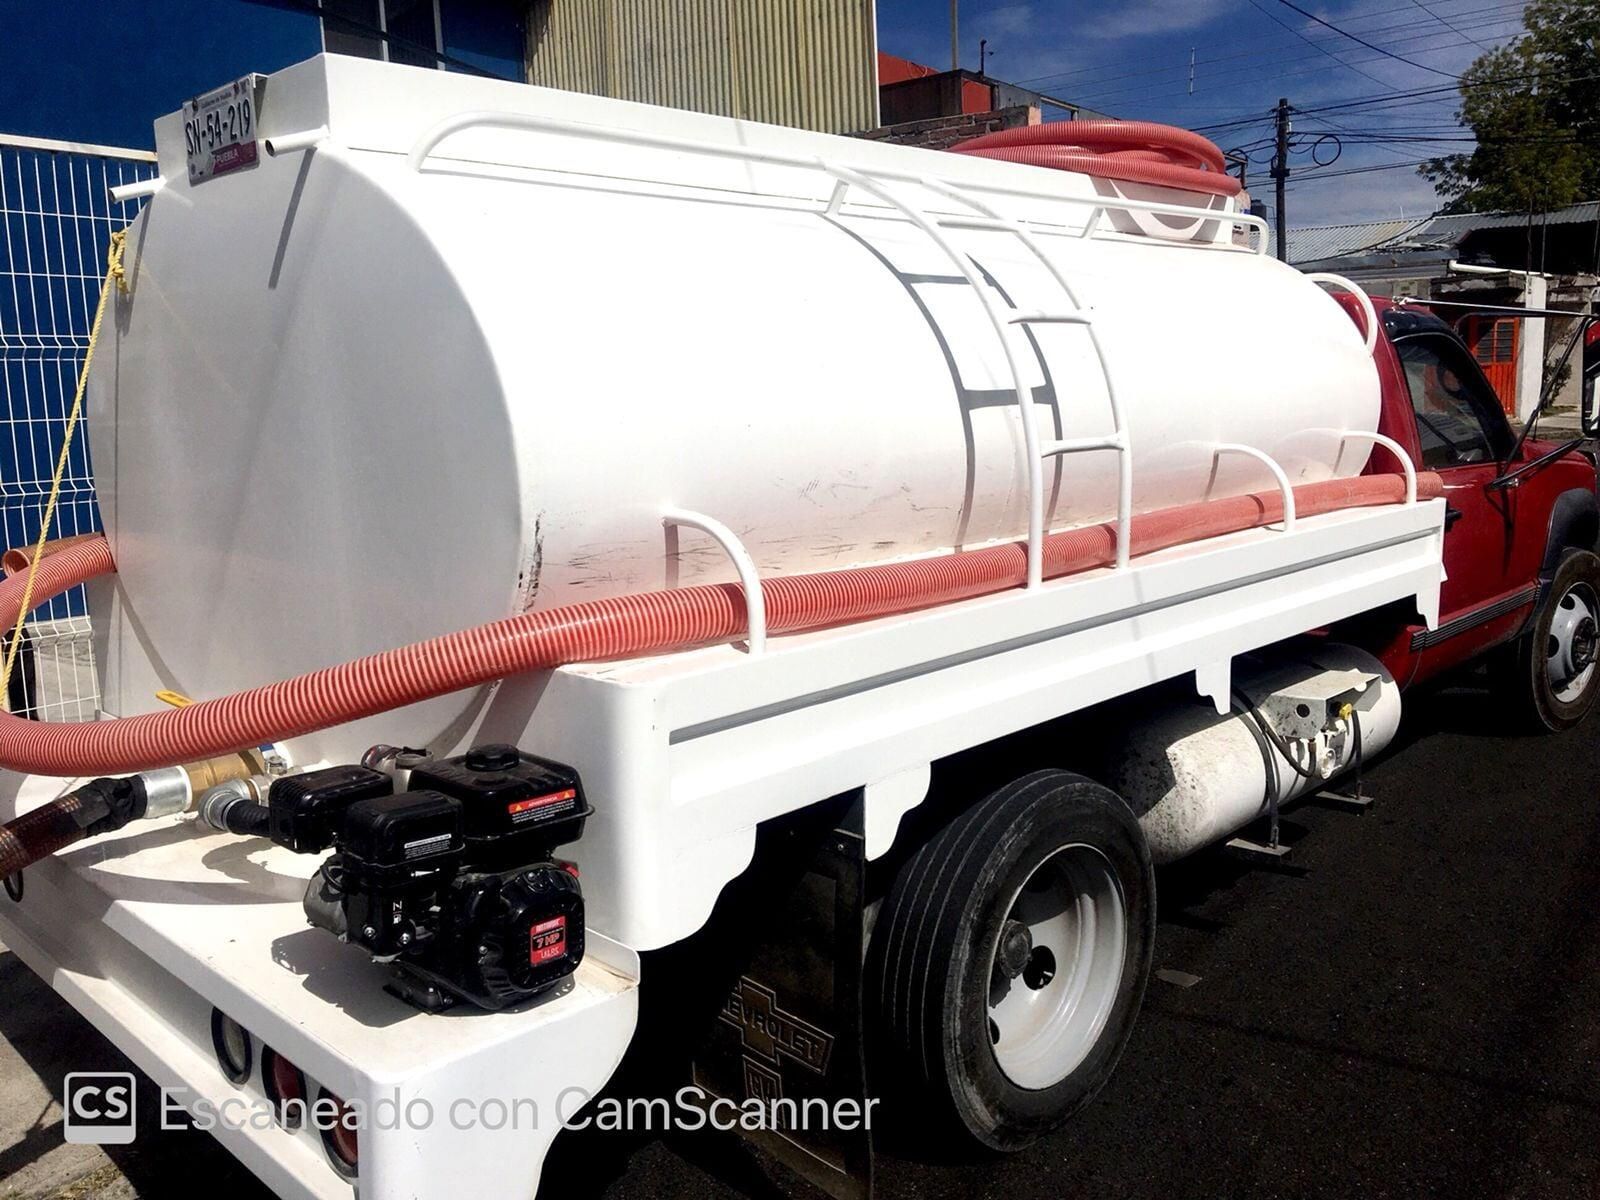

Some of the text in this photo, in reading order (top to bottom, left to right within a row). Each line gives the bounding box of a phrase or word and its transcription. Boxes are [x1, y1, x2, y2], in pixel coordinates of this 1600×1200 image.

[185, 99, 250, 156] SN-54-219
[215, 148, 239, 164] PUEBLA
[536, 937, 544, 949] 7
[544, 932, 560, 946] HP
